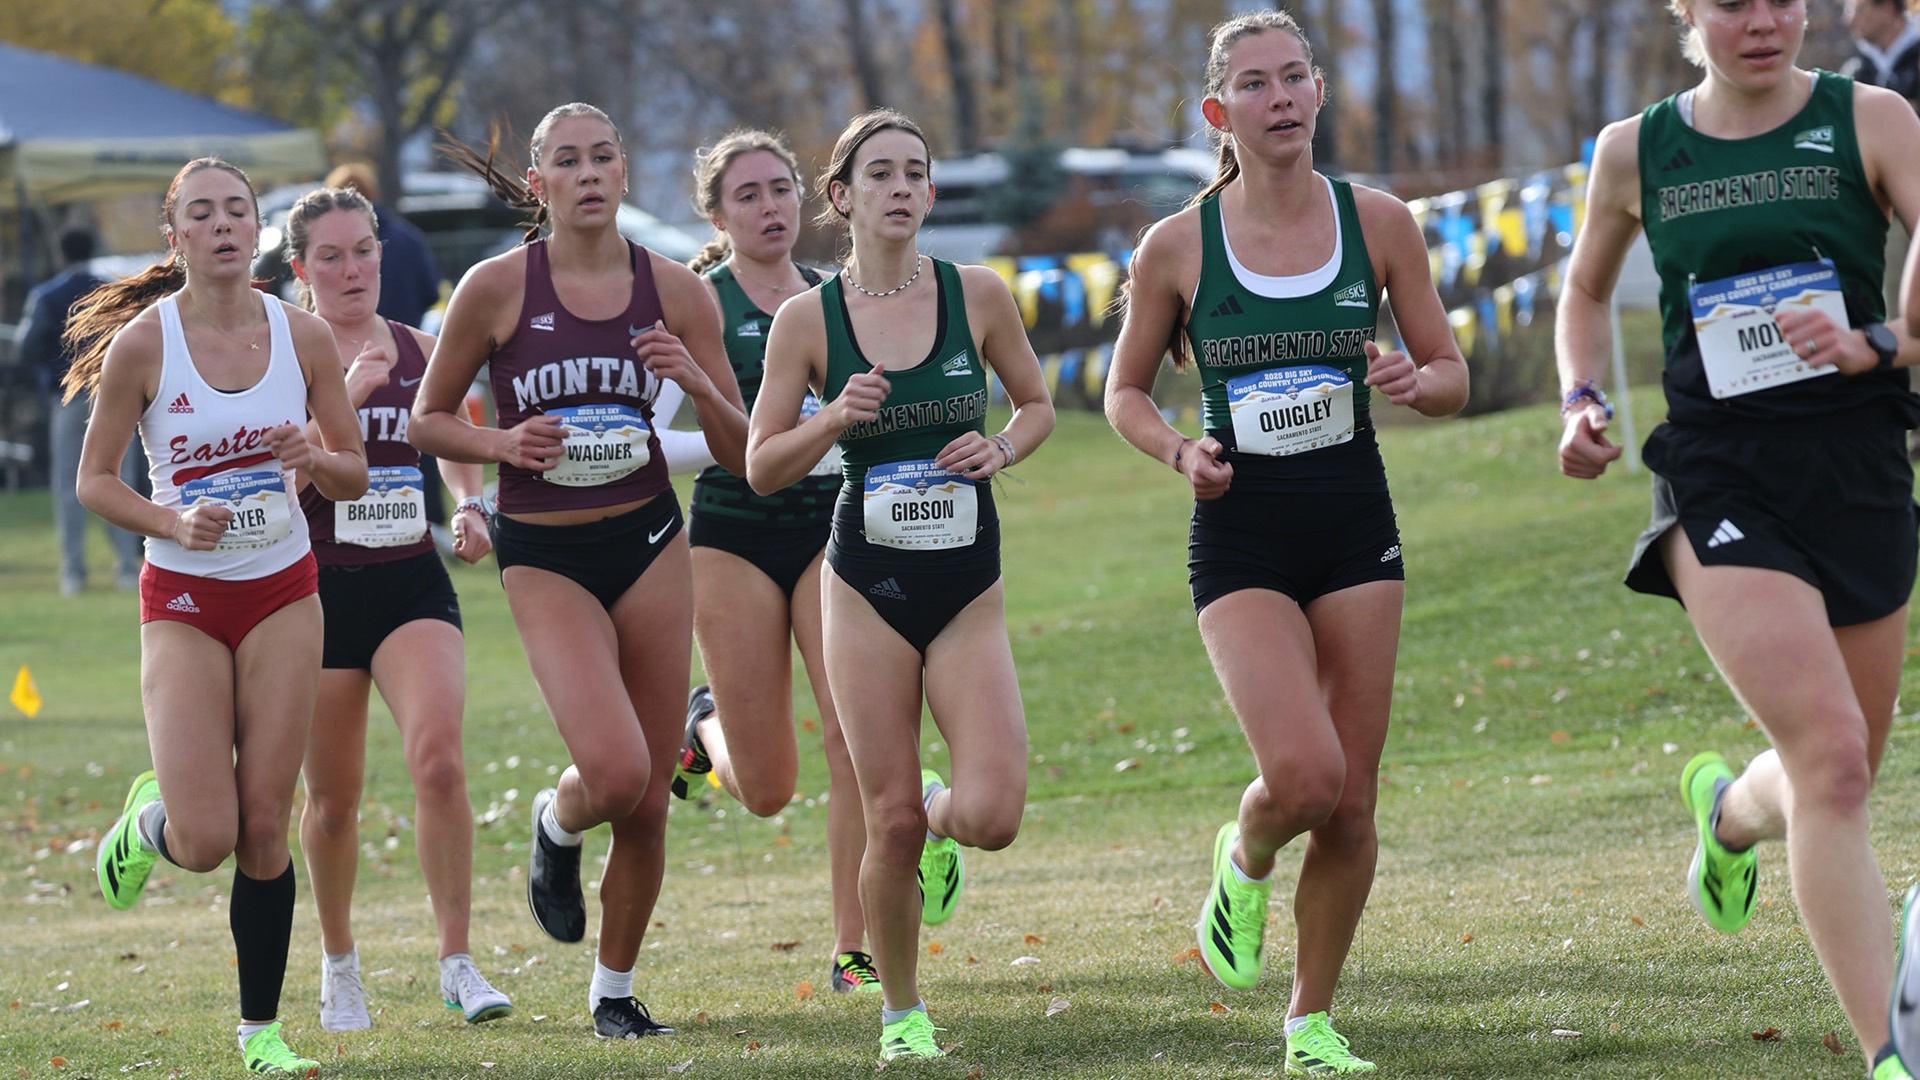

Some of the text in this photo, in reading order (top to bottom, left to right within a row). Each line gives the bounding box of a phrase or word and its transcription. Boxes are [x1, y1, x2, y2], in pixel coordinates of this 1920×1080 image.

[1658, 166, 1840, 223] SACRAMENTO STATE
[1775, 269, 1793, 279] SKY
[1697, 269, 1834, 307] CROSS COUNTRY CHAMPIONSHIP
[1202, 330, 1327, 367] SACRAMENTO
[1299, 369, 1313, 377] SKY
[1233, 373, 1346, 396] CROSS COUNTRY CHAMPIONSHIP
[168, 405, 195, 413] adidas
[577, 408, 594, 416] 2025
[607, 407, 619, 415] SKY
[838, 388, 986, 441] CRAMENTO STATE
[1259, 397, 1332, 433] QUIGLEY
[601, 415, 641, 423] CHAMPIONSHIP
[170, 419, 291, 464] Easter
[1277, 425, 1322, 441] SACRAMENTO STATE
[568, 443, 632, 462] WAGNER
[186, 477, 280, 496] CROSS COUNTRY CHAMPIONSHIP
[870, 475, 891, 484] CROSS
[892, 471, 922, 479] COUNTRY
[226, 508, 266, 530] EYER
[348, 502, 418, 521] BRADFORD
[891, 500, 954, 522] GIBSON
[870, 588, 907, 600] adidas
[166, 602, 200, 613] adidas
